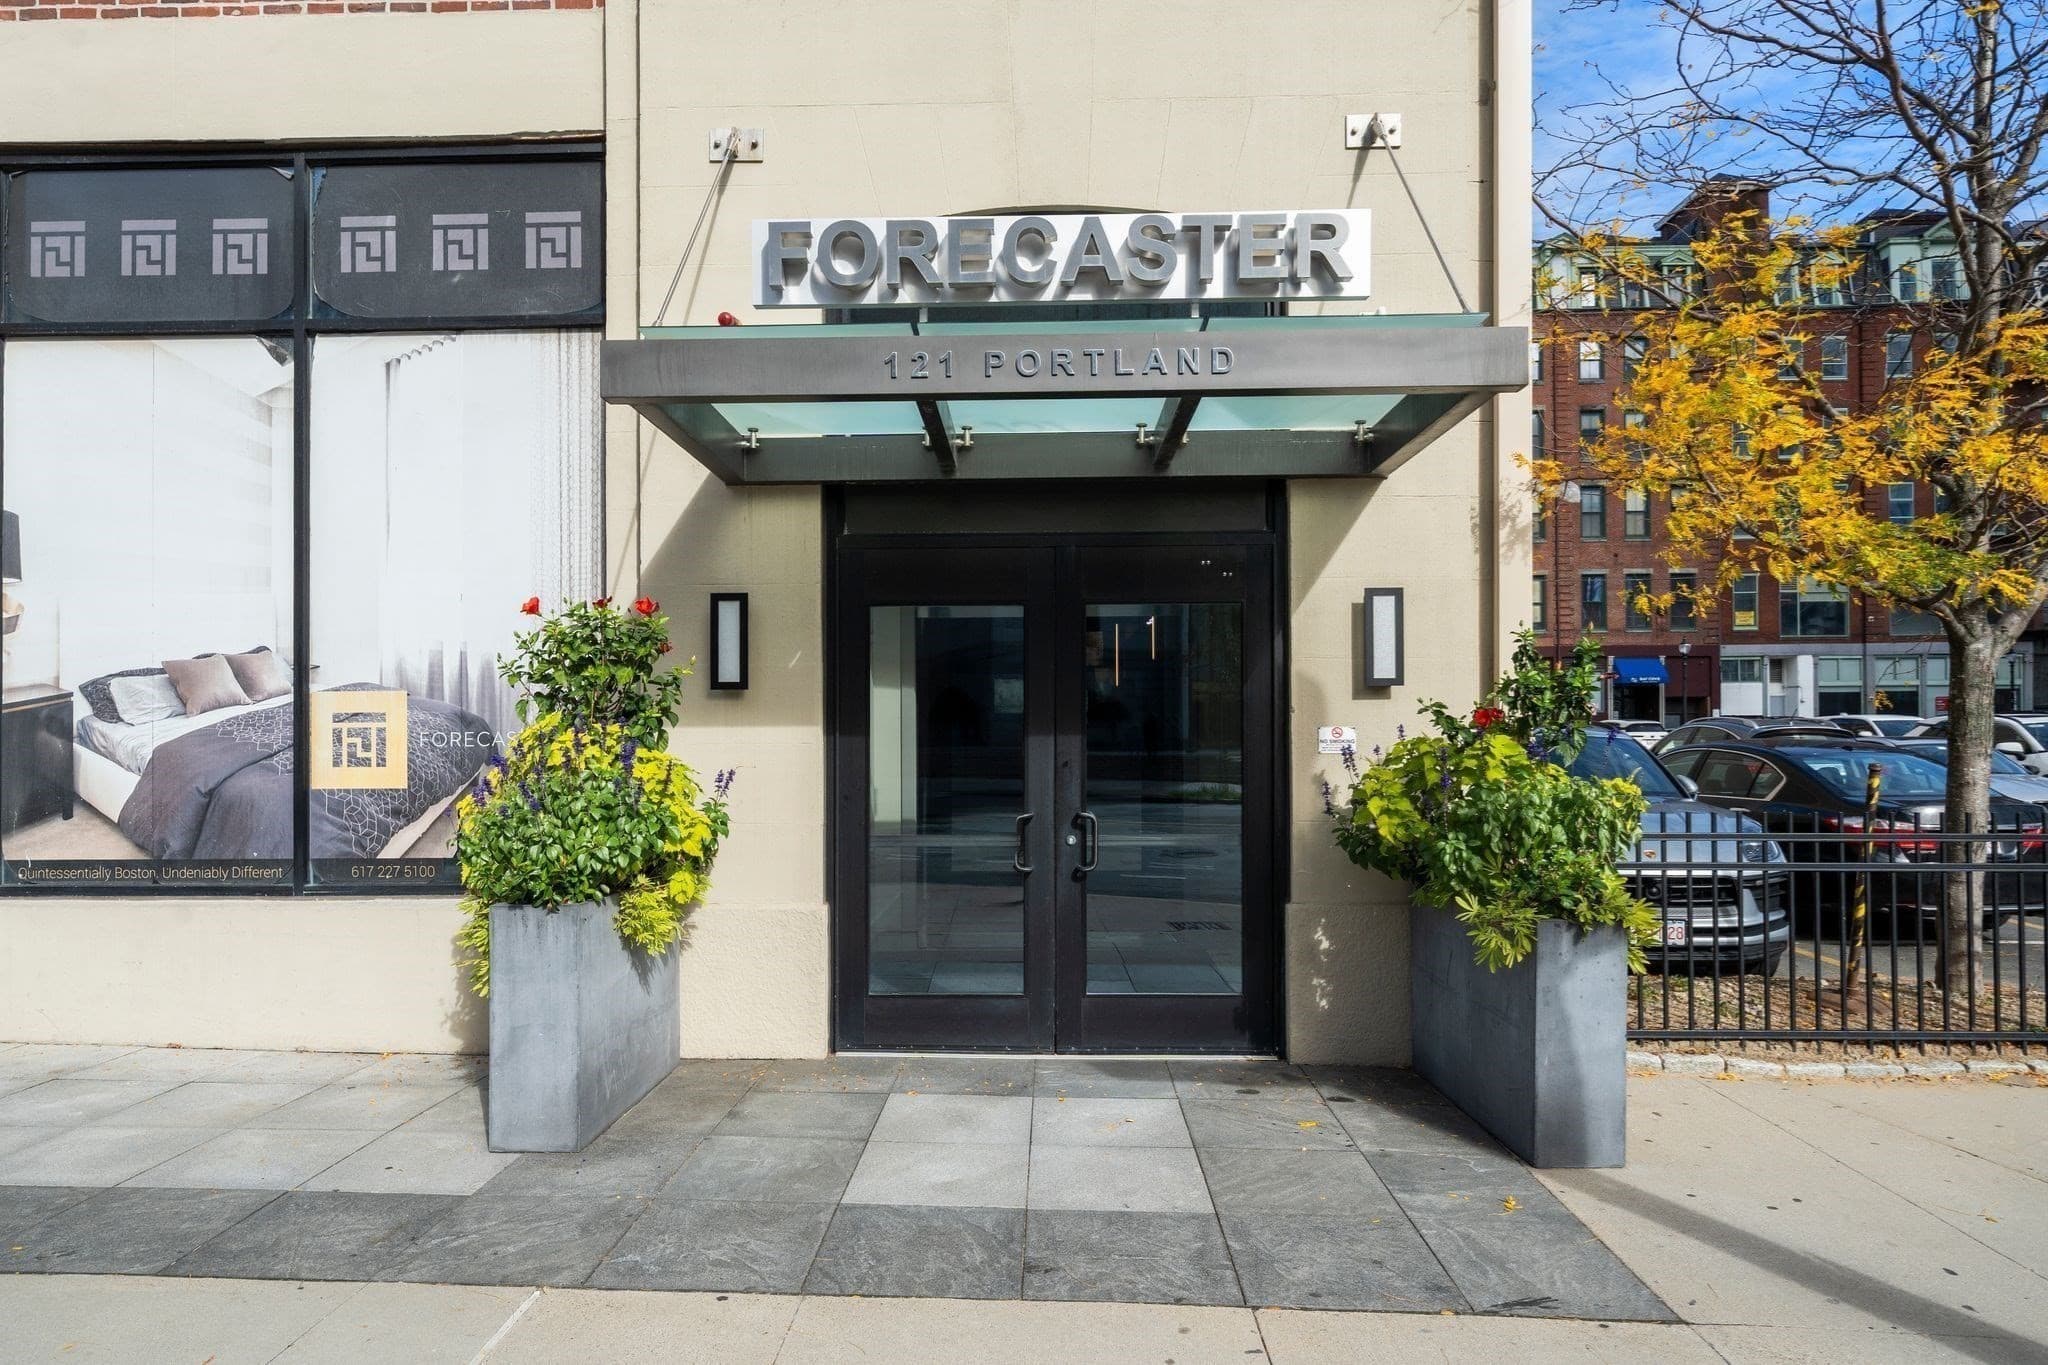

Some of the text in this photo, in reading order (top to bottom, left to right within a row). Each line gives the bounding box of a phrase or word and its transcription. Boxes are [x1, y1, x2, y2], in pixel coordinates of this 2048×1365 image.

[767, 213, 1353, 289] FORECASTER
[884, 346, 1235, 379] 121 PORTLAND
[419, 731, 518, 747] FORECAS
[18, 866, 112, 882] Quintessentially
[162, 866, 229, 881] Undeniably
[231, 866, 283, 879] Different
[351, 865, 435, 878] 617 227 5100
